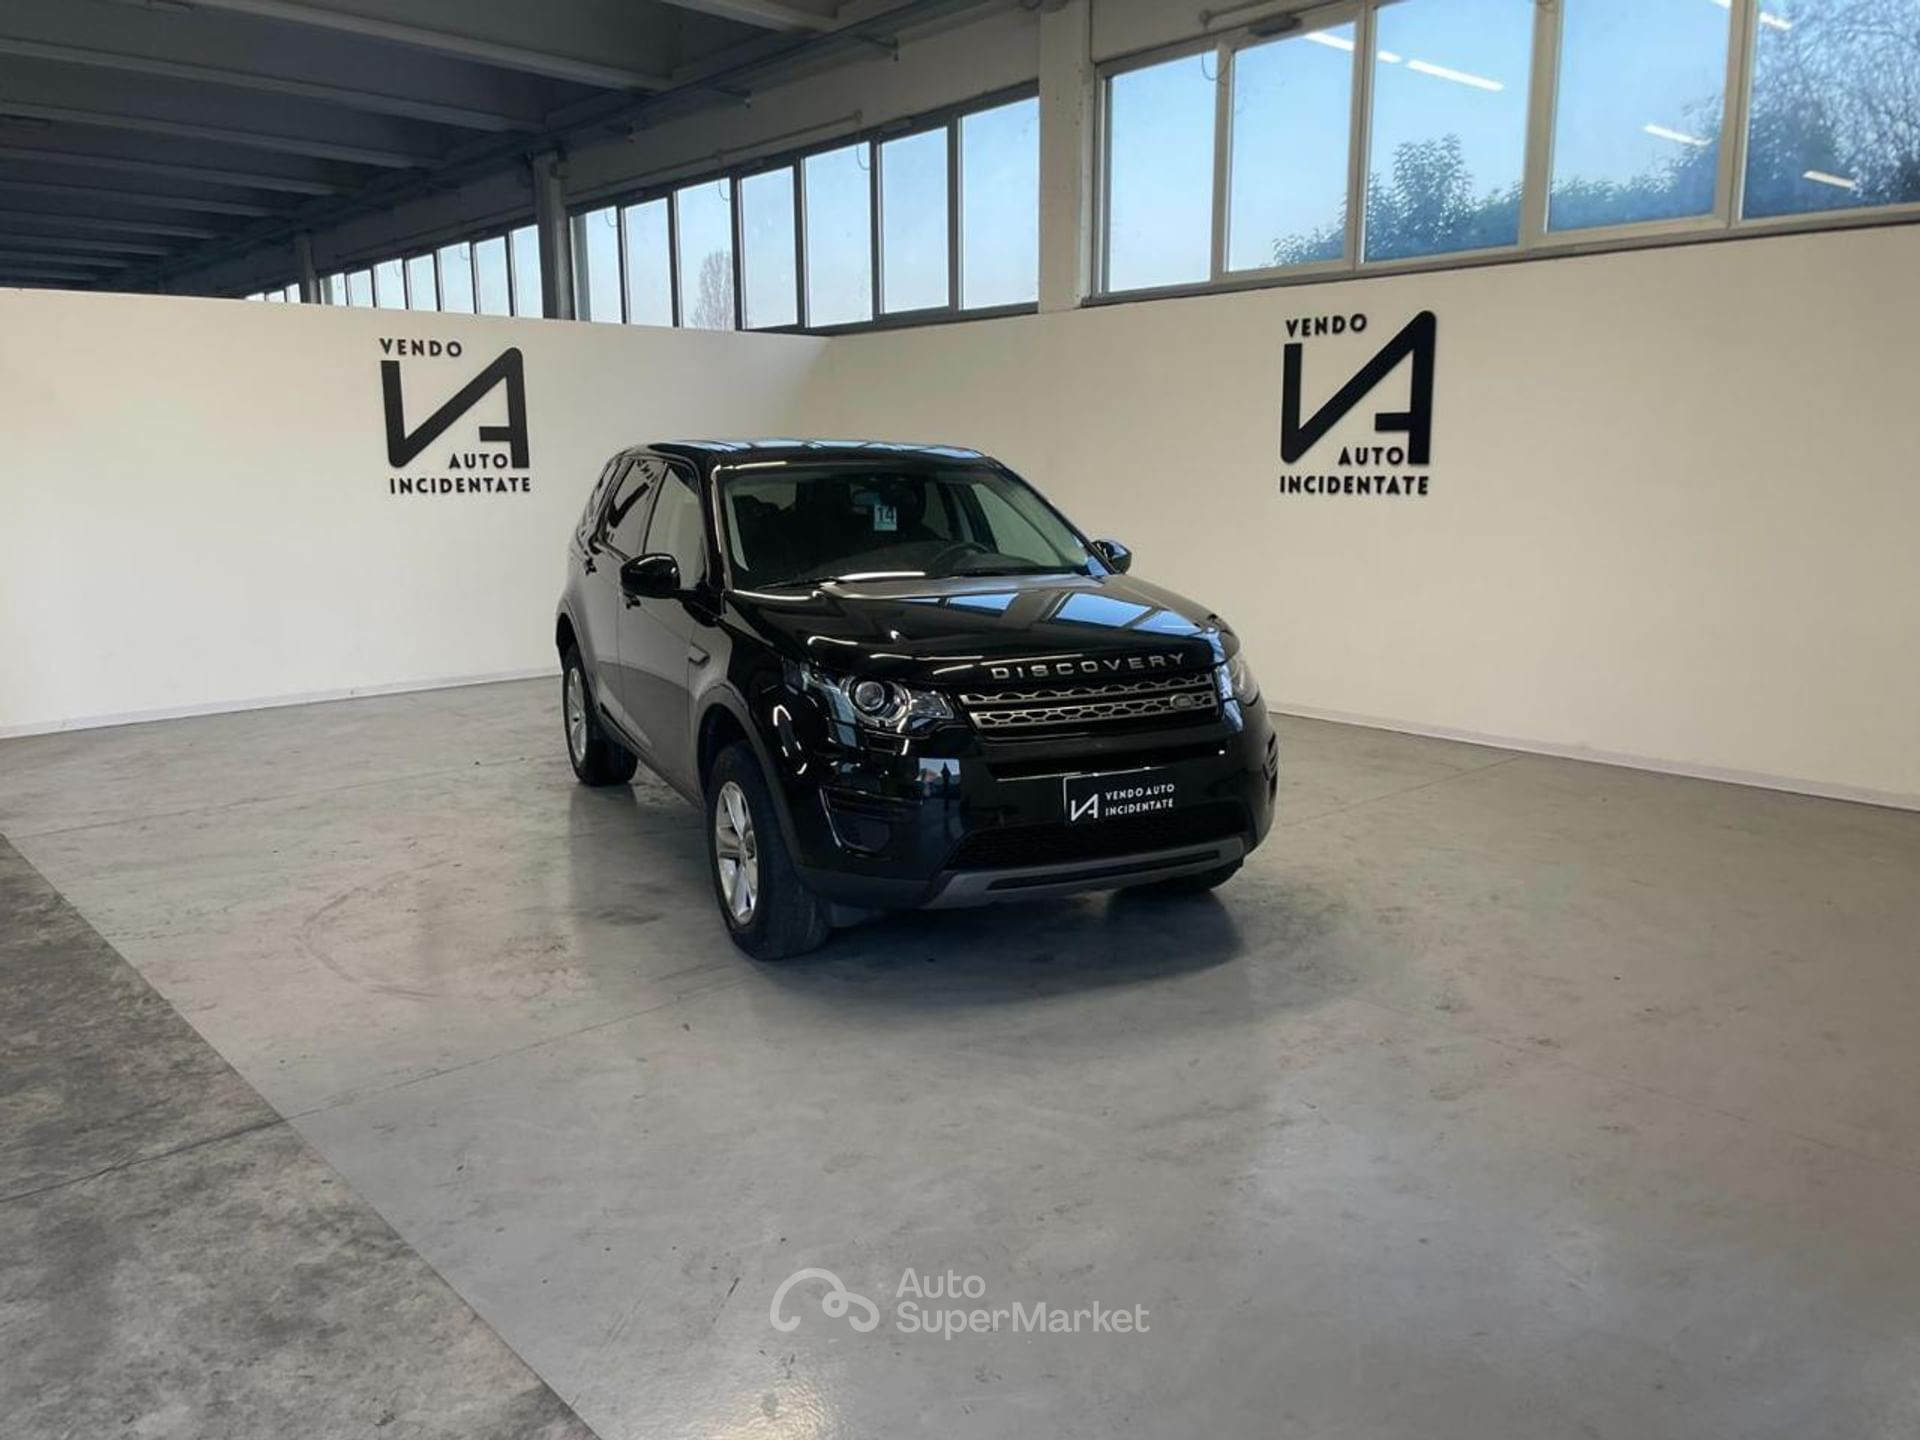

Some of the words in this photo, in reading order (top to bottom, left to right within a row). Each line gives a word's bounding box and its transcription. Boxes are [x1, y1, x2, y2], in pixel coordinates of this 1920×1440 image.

[1285, 313, 1367, 338] VENDO
[379, 338, 463, 358] VENDO
[448, 453, 508, 469] AUTO
[1338, 447, 1404, 465] AUTO
[389, 477, 531, 494] INCIDENTATE
[1279, 475, 1429, 495] INCIDENTATE
[877, 504, 894, 524] 14
[990, 652, 1184, 680] DISCOVERY
[1105, 787, 1143, 800] VENDO
[1145, 783, 1175, 796] AUTO
[1105, 798, 1173, 816] INCIDENTATE
